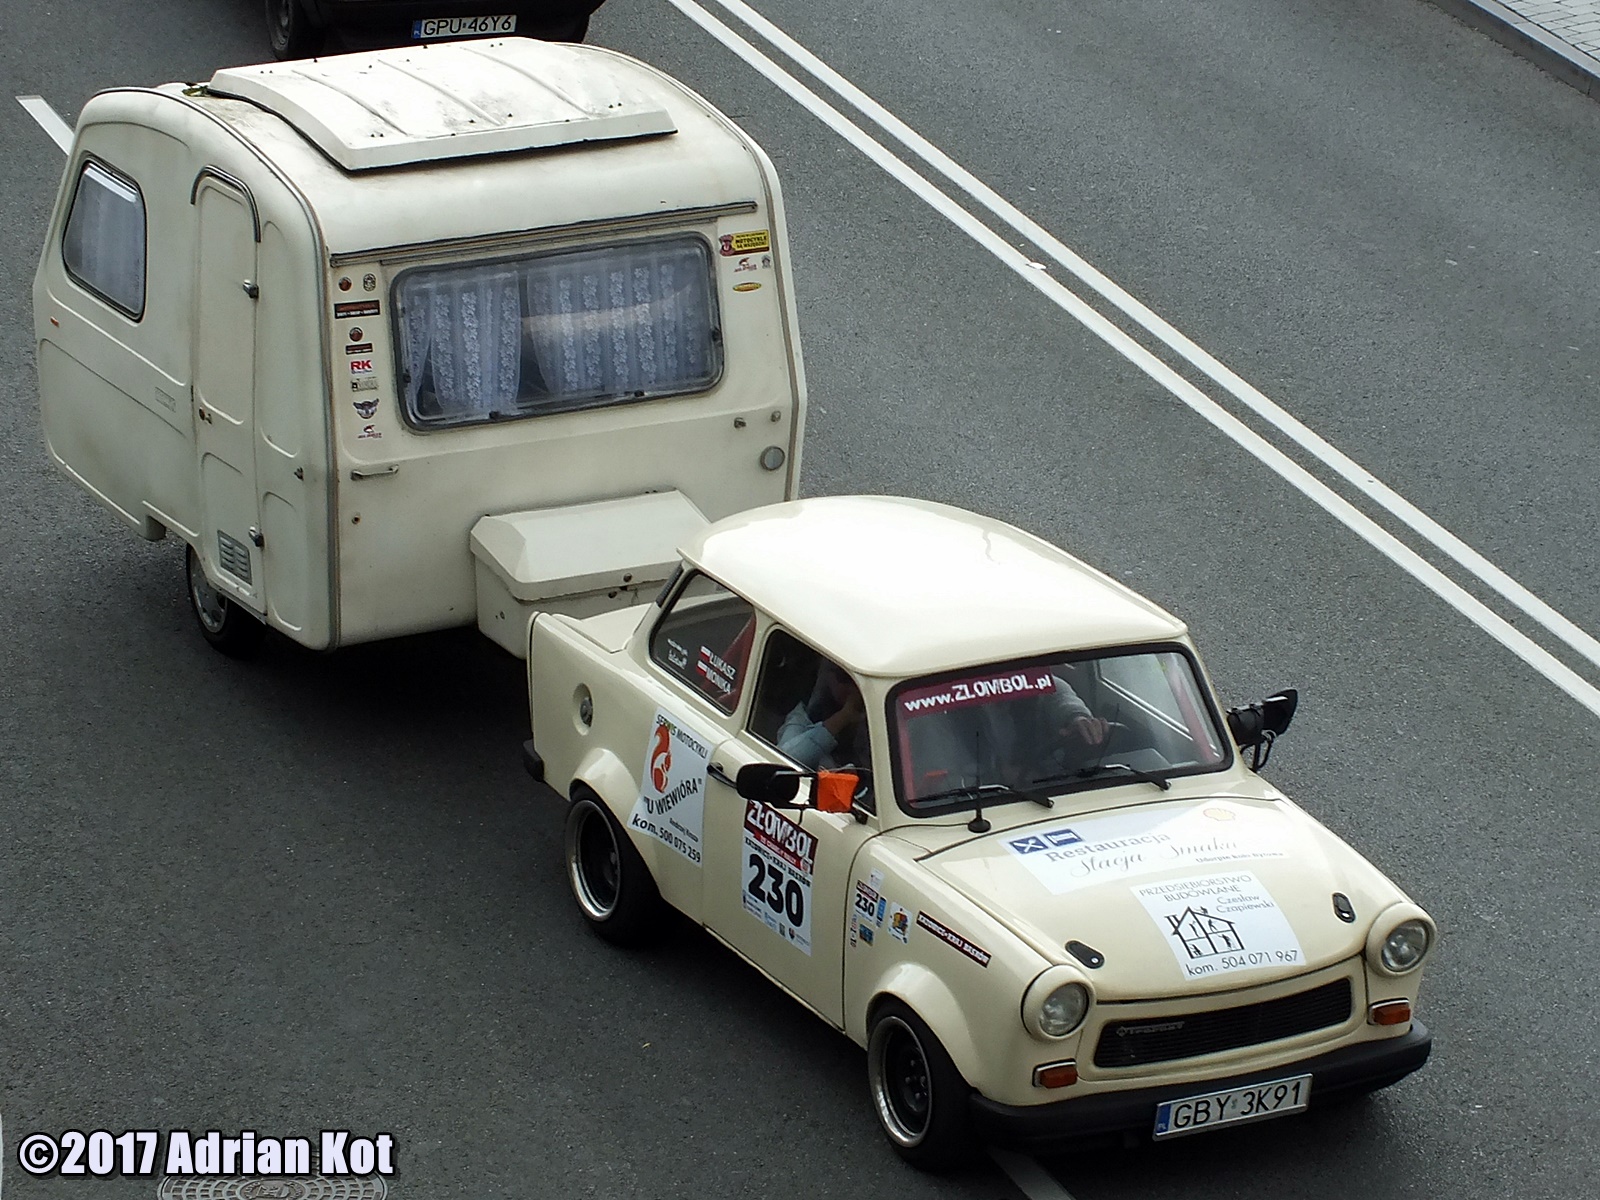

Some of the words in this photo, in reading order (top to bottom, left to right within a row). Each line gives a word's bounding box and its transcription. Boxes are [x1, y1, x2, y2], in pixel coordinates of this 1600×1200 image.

[424, 20, 462, 35] GPU
[468, 16, 512, 32] 46Y6
[350, 360, 373, 370] RK
[709, 652, 736, 680] ŁUKASZ
[706, 667, 731, 695] MONIKA
[676, 729, 709, 759] MOTOCYKLI
[632, 813, 658, 836] kom.
[659, 827, 673, 844] 500
[674, 836, 686, 854] 075
[687, 845, 701, 863] 259
[1045, 832, 1171, 863] Restauracja
[748, 853, 804, 928] 230
[1139, 874, 1252, 897] PRZEDSIĘBIORSTWO
[855, 893, 875, 917] 230
[1215, 899, 1275, 914] Czapiewski
[1186, 962, 1218, 976] kom.
[1221, 954, 1246, 970] 504
[1248, 951, 1272, 965] 071
[1276, 949, 1299, 963] 967
[1174, 1095, 1232, 1129] GBY
[1240, 1081, 1301, 1116] 3K91
